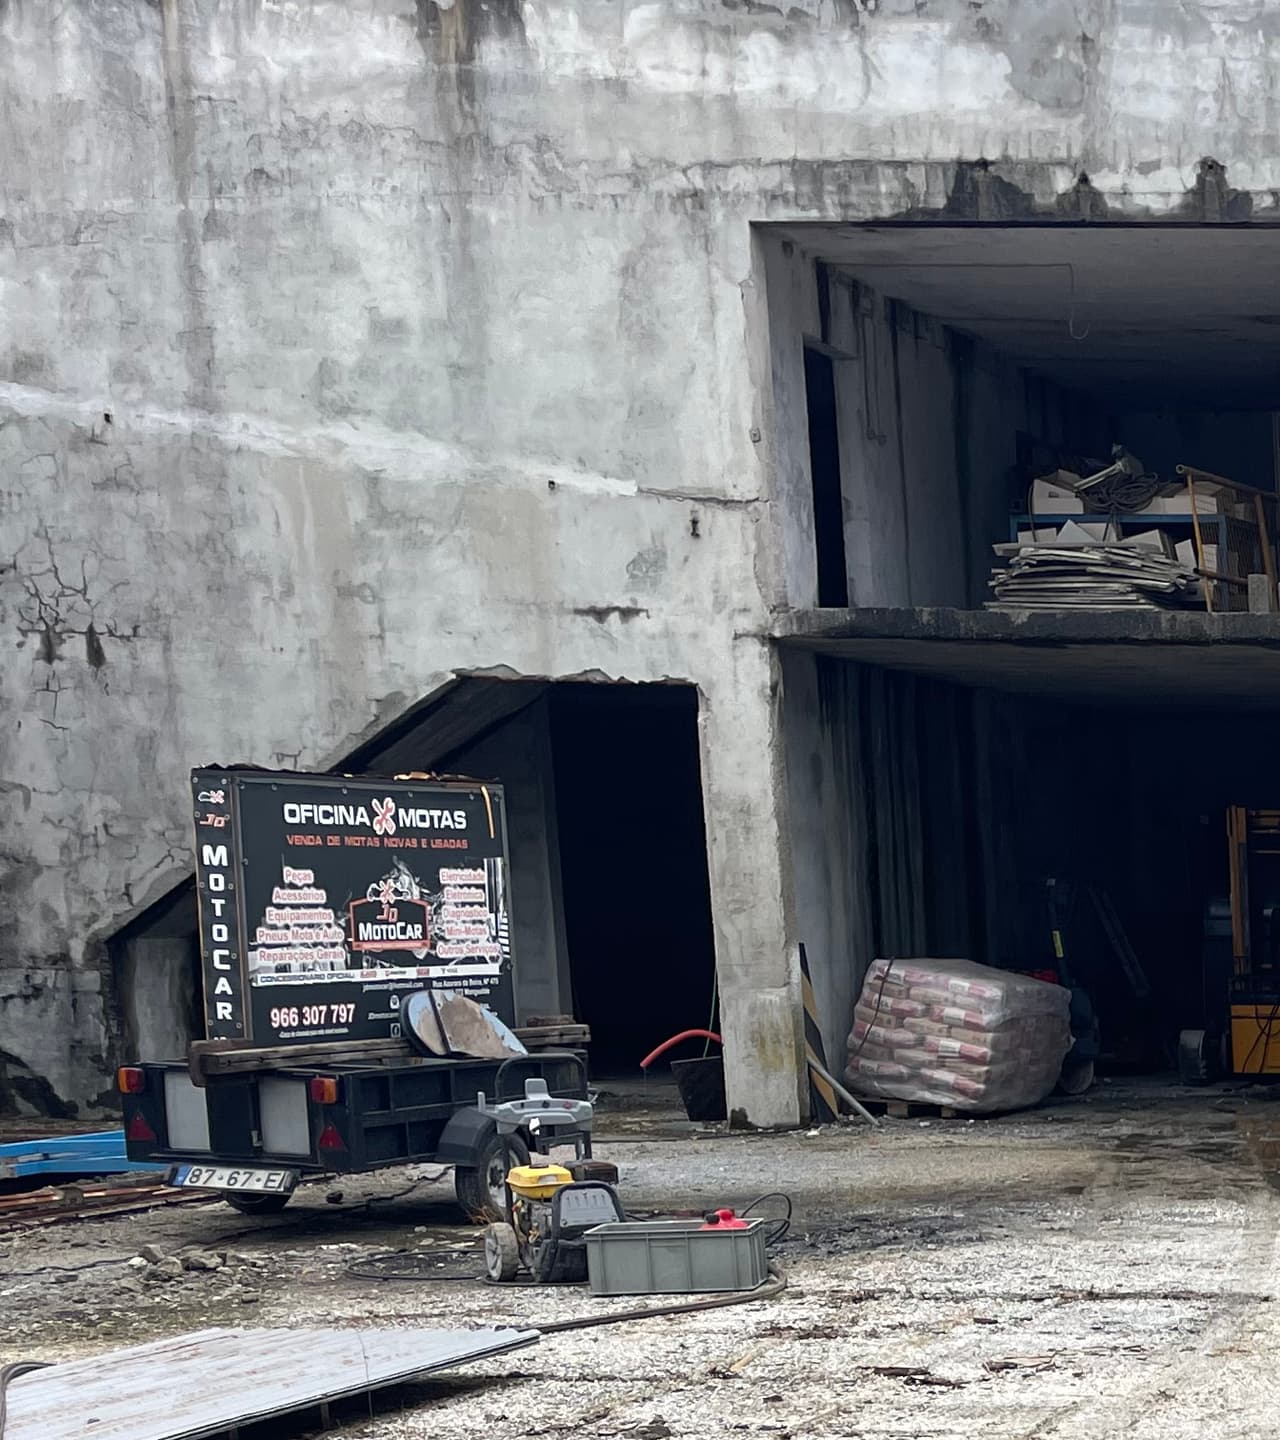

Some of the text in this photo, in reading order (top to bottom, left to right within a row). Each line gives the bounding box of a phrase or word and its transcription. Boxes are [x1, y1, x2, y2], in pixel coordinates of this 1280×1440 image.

[284, 803, 467, 829] OFICINA MOTAS
[286, 834, 323, 846] VENDA
[327, 835, 341, 846] DE
[345, 836, 380, 847] MOTAS
[384, 837, 417, 848] NOVAS
[430, 839, 468, 849] USADAS
[267, 909, 333, 922] Equipamentos
[258, 930, 288, 941] Pneus
[270, 1003, 355, 1028] 966 307 797
